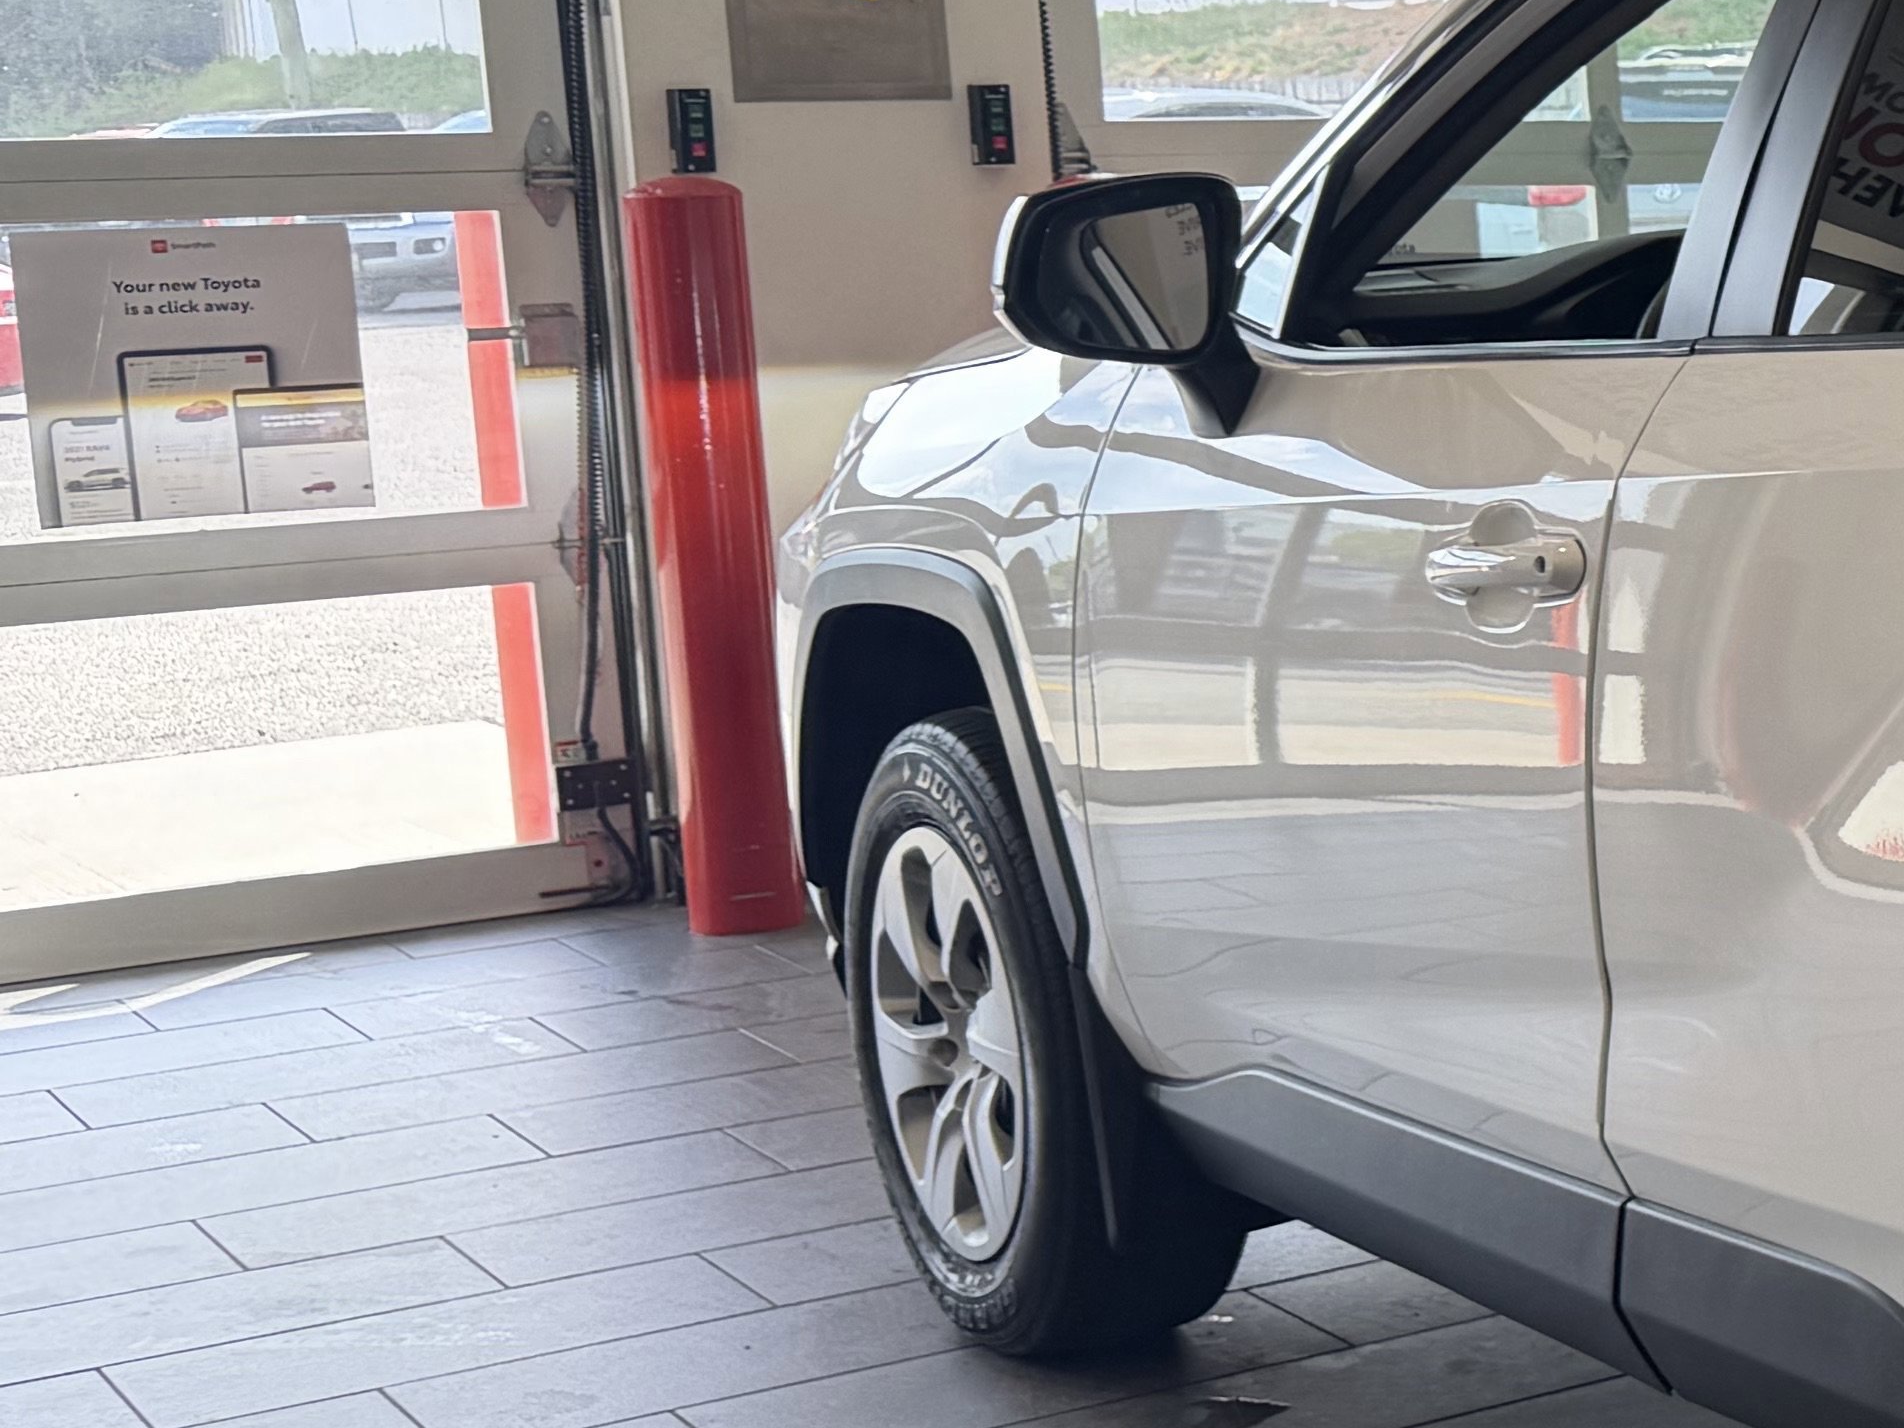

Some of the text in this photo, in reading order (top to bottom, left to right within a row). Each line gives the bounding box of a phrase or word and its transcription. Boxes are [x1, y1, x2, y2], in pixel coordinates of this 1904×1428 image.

[112, 277, 261, 294] Your new Toyota
[124, 300, 255, 316] is a click away.
[914, 762, 1003, 897] DUNLOP
